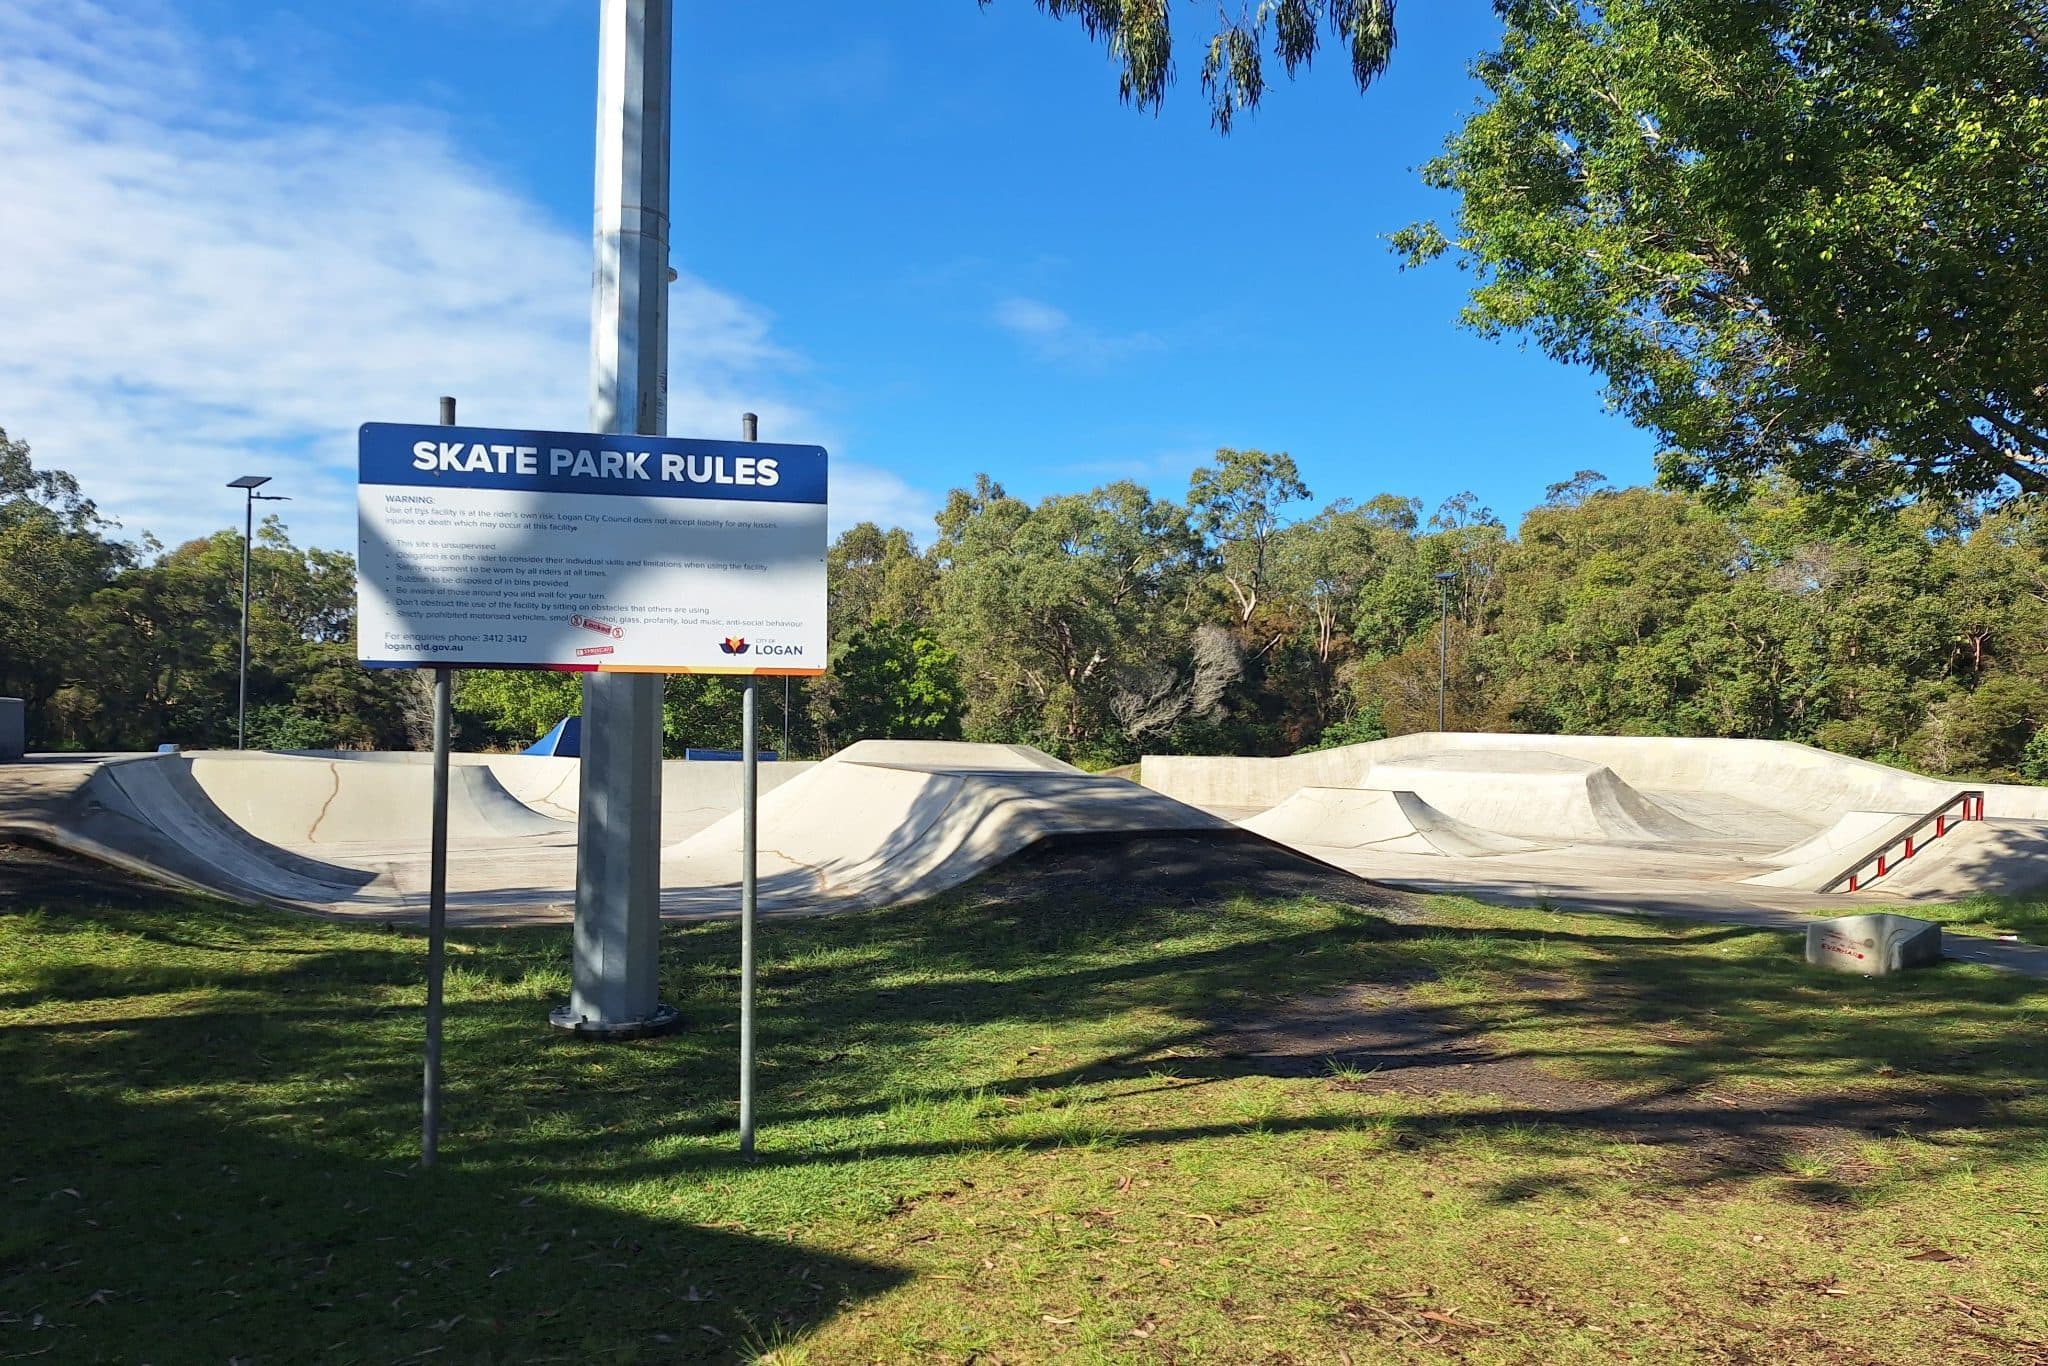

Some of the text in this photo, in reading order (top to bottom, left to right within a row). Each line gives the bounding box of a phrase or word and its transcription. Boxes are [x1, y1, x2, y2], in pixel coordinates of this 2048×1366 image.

[412, 441, 779, 487] SKATE PARK RULES
[385, 517, 414, 526] injuries
[428, 518, 452, 526] death
[454, 519, 477, 527] which
[480, 521, 496, 529] may
[415, 507, 429, 515] this
[432, 508, 456, 517] facility
[493, 510, 517, 518] rider's
[558, 513, 582, 522] Logan
[585, 514, 600, 523] City
[602, 515, 631, 523] Council
[669, 518, 695, 527] accept
[697, 519, 723, 528] liability
[396, 539, 413, 547] This
[396, 551, 439, 561] Obligation
[462, 553, 476, 561] the
[509, 555, 544, 563] consider
[546, 556, 563, 564] their
[566, 557, 603, 565] individual
[606, 558, 625, 566] skills
[643, 559, 682, 568] limitations
[707, 562, 727, 571] using
[729, 562, 742, 570] the
[424, 564, 468, 573] equipment
[516, 567, 526, 575] by
[455, 576, 492, 586] disposed
[447, 588, 471, 596] those
[473, 589, 501, 597] around
[456, 600, 470, 608] the
[514, 602, 539, 611] facility
[541, 603, 551, 611] by
[554, 603, 577, 612] sitting
[426, 611, 468, 620] prohibited
[385, 632, 528, 643] For enquiries phone: 3412 3412
[385, 642, 464, 653] logan.qld.gov.au
[755, 644, 803, 656] LOGAN
